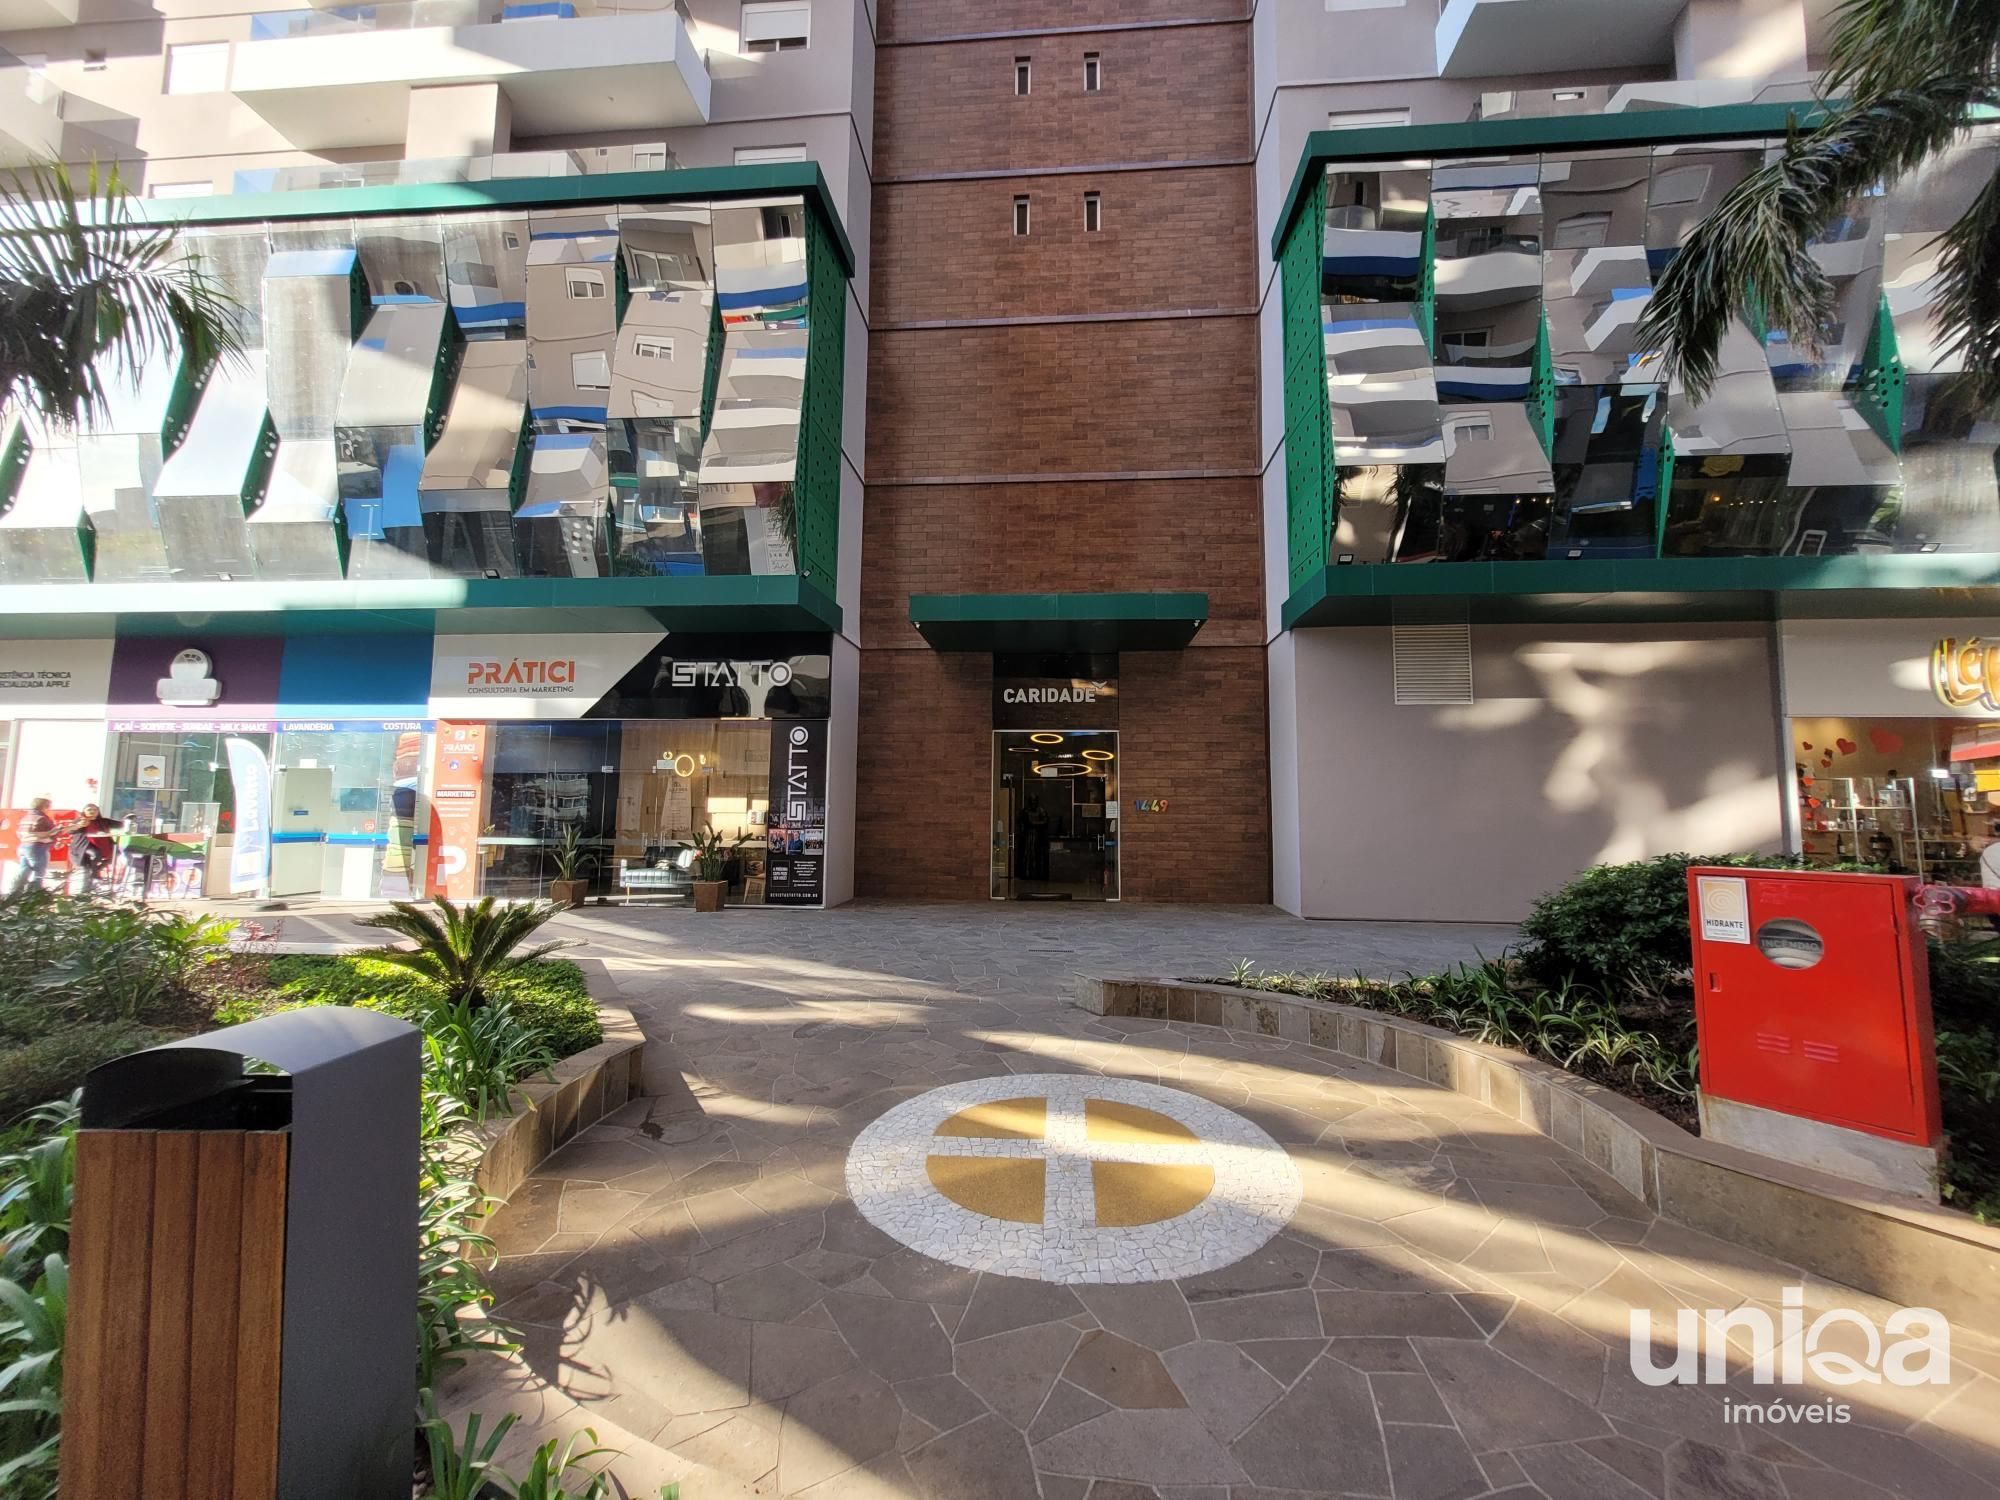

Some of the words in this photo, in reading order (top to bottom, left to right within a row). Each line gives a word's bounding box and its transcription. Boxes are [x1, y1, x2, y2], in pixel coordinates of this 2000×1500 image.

[468, 658, 575, 684] PRÁTICI
[672, 661, 792, 687] STATTO
[46, 680, 71, 688] APPLE
[531, 685, 574, 693] MARKETING
[1003, 687, 1097, 703] CARIDADE
[282, 723, 335, 731] LAVANDERIA
[383, 722, 422, 731] COSTURA
[786, 726, 809, 821] STATTO
[1134, 800, 1169, 812] 1449
[1706, 919, 1744, 930] HIDRANTE
